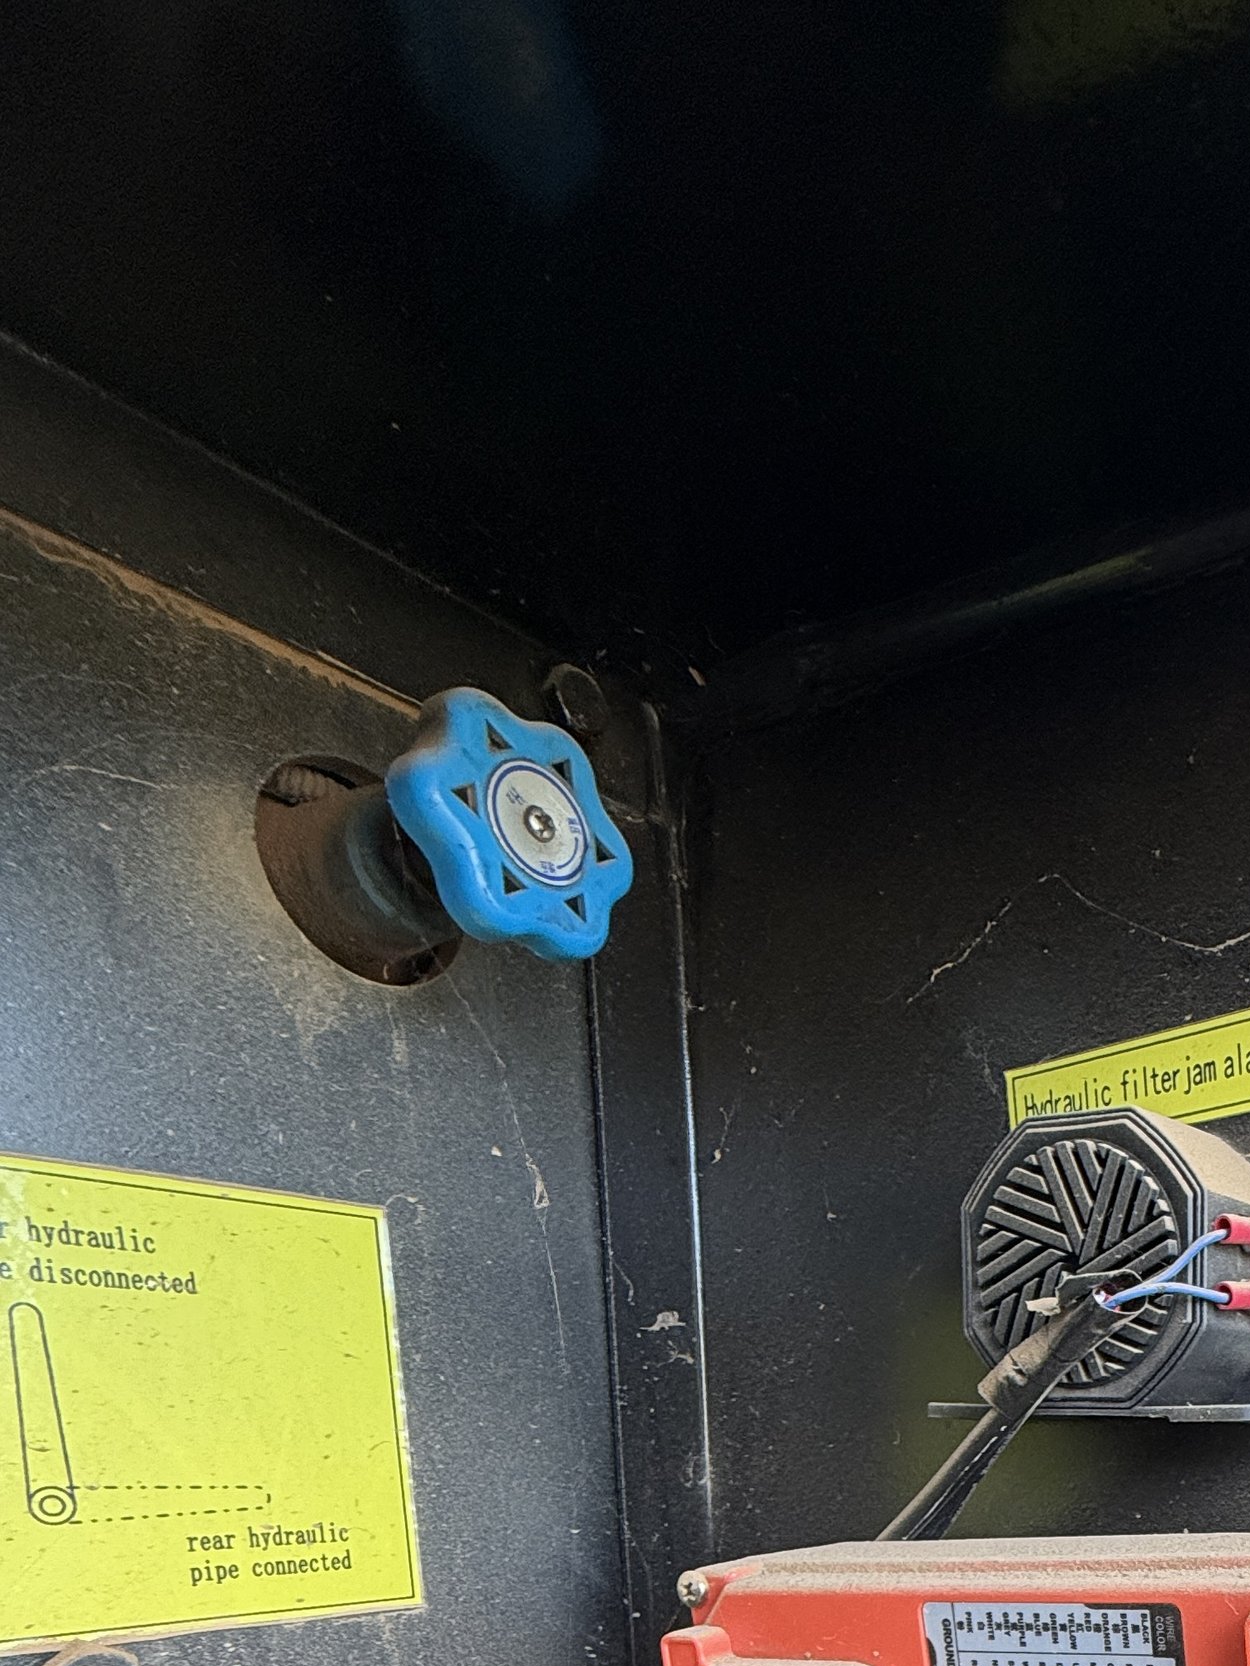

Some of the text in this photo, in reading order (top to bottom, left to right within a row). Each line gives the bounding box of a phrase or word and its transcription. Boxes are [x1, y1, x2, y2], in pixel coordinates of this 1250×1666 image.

[25, 1216, 156, 1254] hydraulic
[29, 1257, 198, 1295] disconnected
[187, 1522, 349, 1553] rear hydraulic
[190, 1551, 352, 1587] pipe connected
[965, 1611, 974, 1633] PINK
[985, 1611, 995, 1641] WHITE
[1002, 1612, 1011, 1637] GREY
[1016, 1612, 1027, 1647] PURPLE
[1033, 1612, 1042, 1636] BLUE
[1049, 1612, 1059, 1644] GREEN
[1067, 1612, 1077, 1650] YELLOW
[1084, 1612, 1092, 1632] RED
[1101, 1612, 1112, 1652] ORANGE
[1120, 1613, 1130, 1649] BROWN
[1140, 1613, 1150, 1644] BLACK
[1155, 1615, 1167, 1651] COLOR
[1165, 1615, 1176, 1642] WIRE
